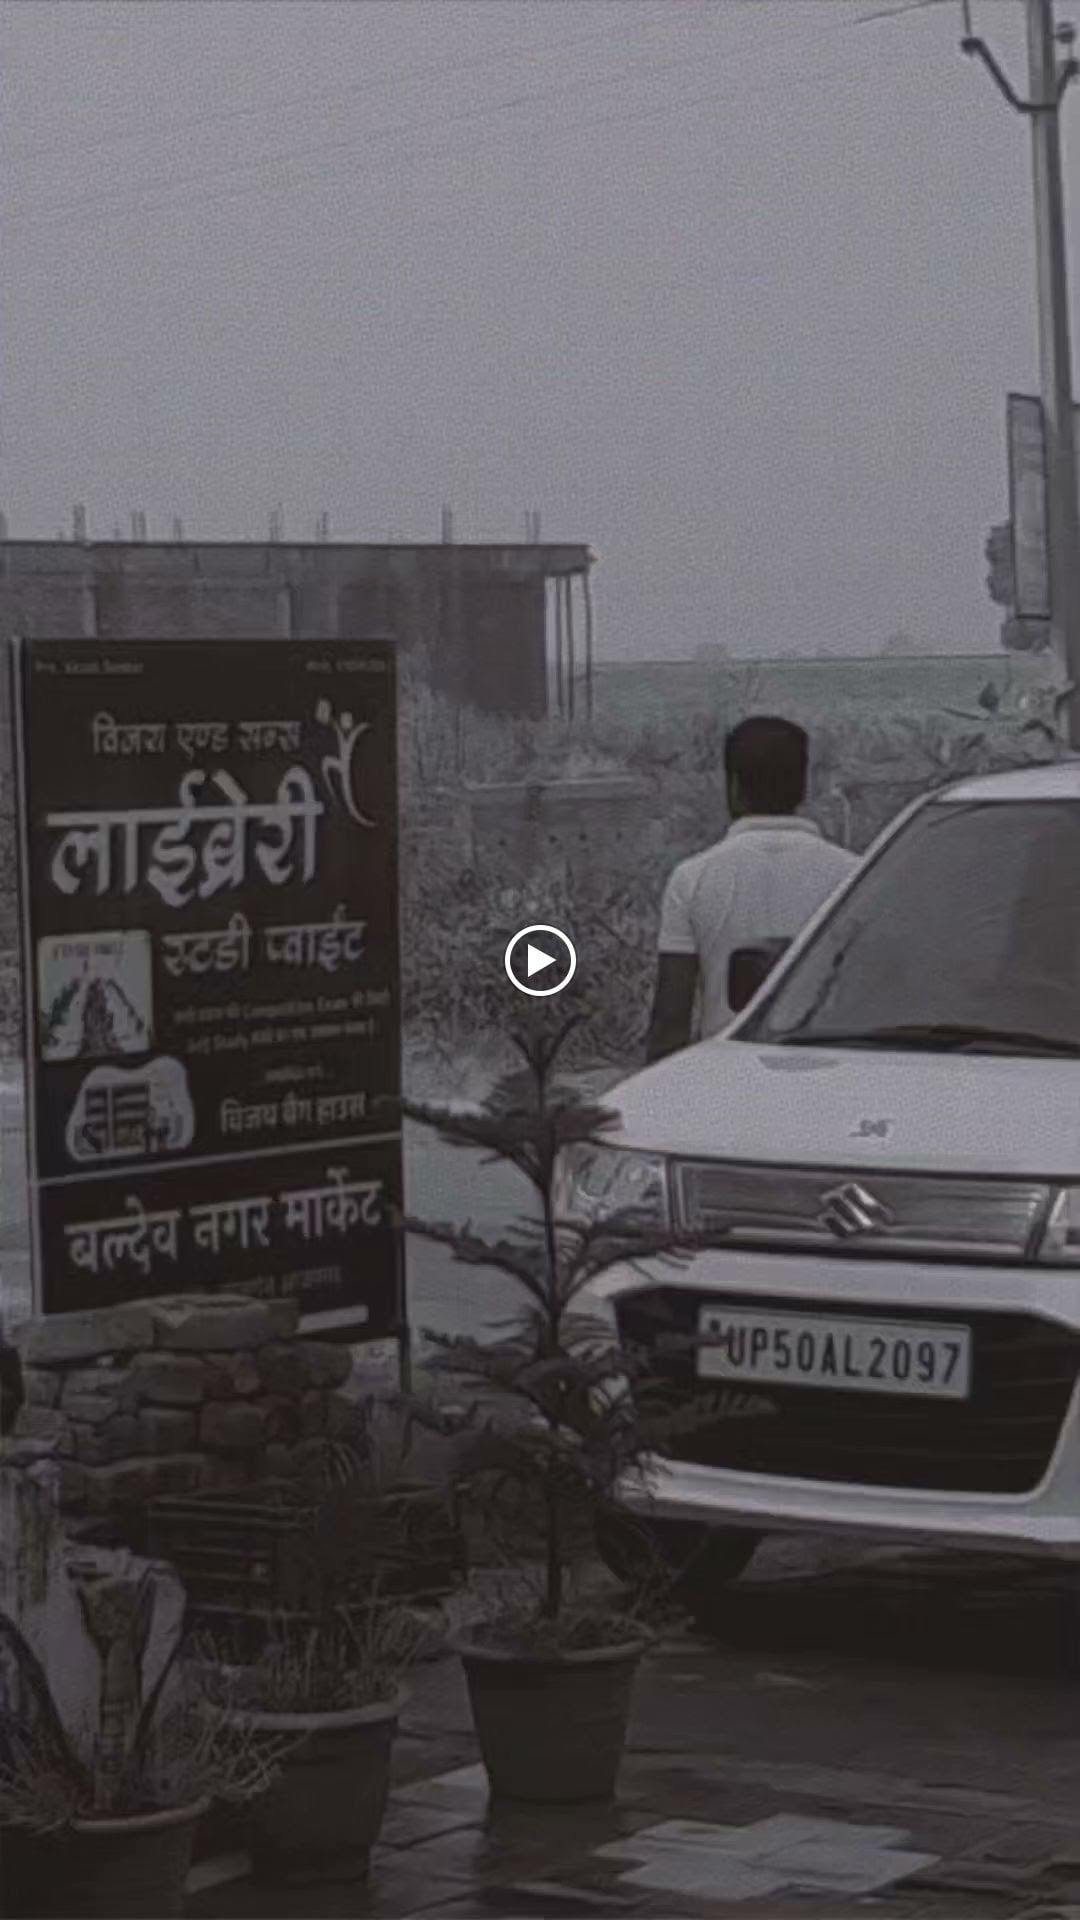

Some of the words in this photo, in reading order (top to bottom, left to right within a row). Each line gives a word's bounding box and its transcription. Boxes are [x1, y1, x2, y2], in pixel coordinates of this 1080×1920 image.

[47, 766, 323, 907] लाईब्रेरी
[64, 1195, 181, 1274] बल्देव
[190, 1196, 271, 1253] नगर
[281, 1166, 383, 1238] मार्केट
[726, 1325, 961, 1384] UP50AL2097
